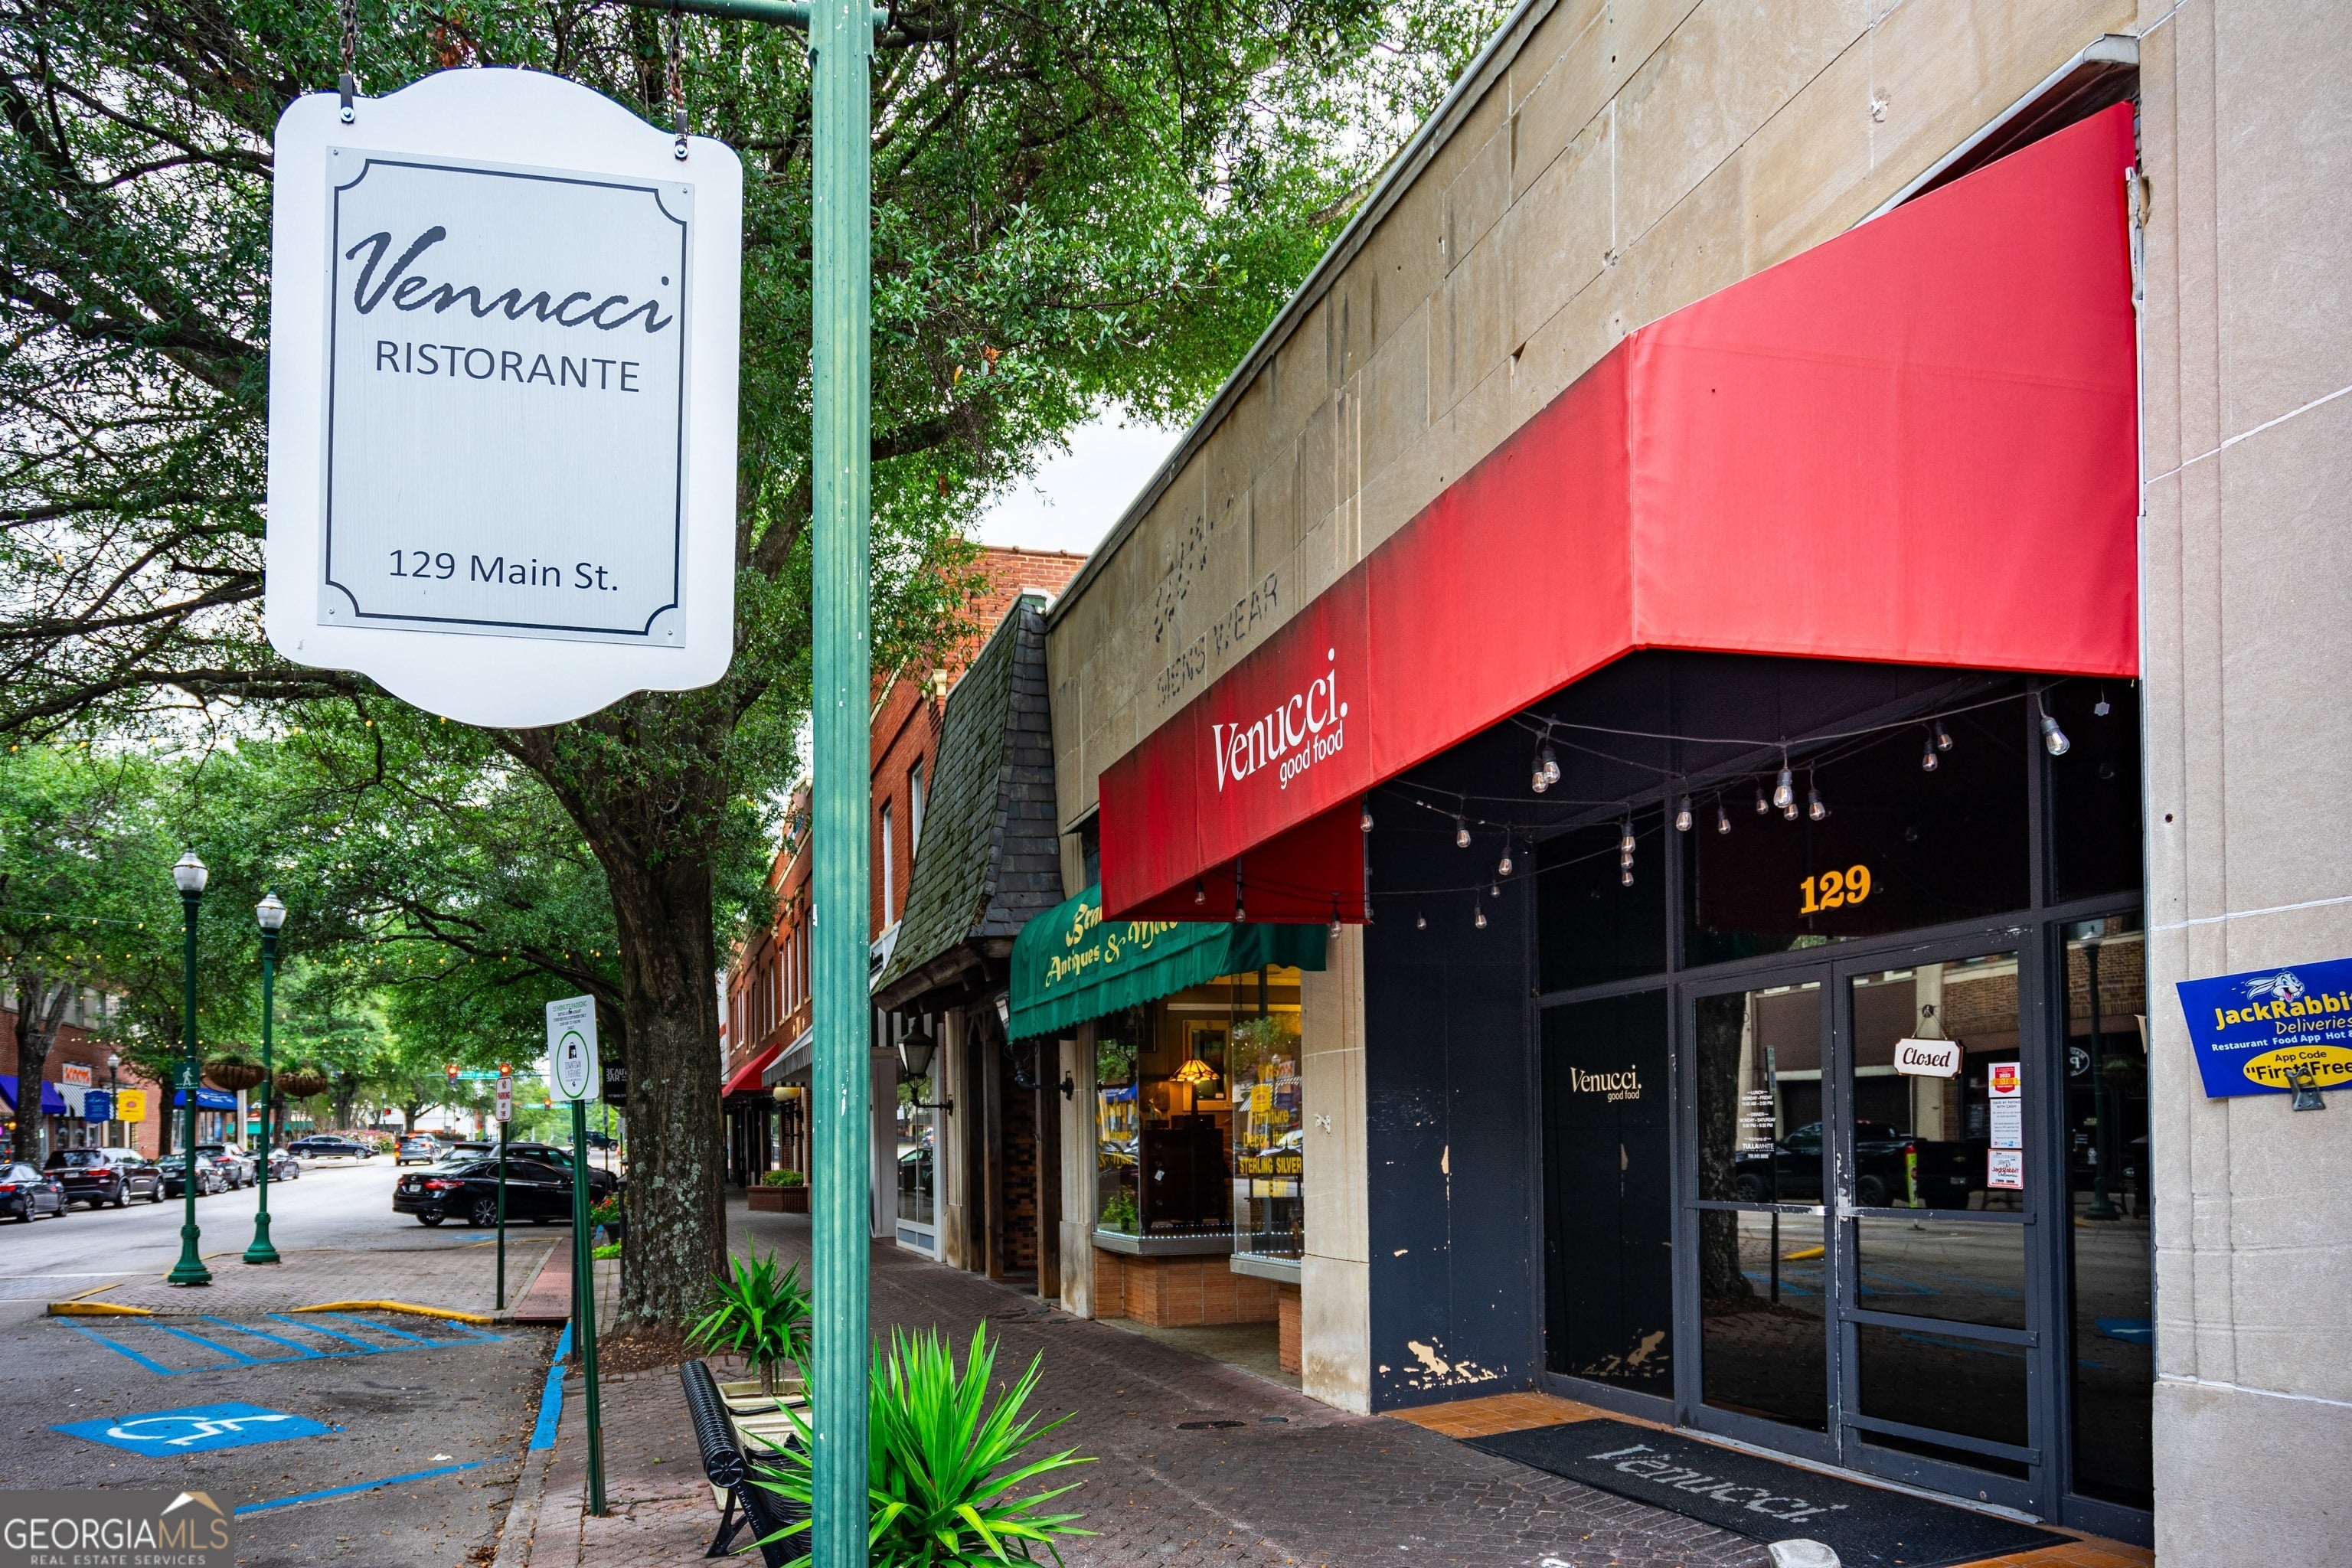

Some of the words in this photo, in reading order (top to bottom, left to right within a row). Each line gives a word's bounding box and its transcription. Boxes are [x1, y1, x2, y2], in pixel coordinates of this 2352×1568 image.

[345, 225, 672, 334] Venucci
[376, 340, 640, 393] RISTORANTE
[388, 550, 456, 580] 129
[470, 554, 562, 588] Main
[574, 562, 619, 592] St.
[1212, 648, 1348, 792] Venucci.
[1279, 740, 1311, 790] good
[1312, 720, 1344, 764] food
[1800, 864, 1871, 914] 129
[1044, 945, 1100, 988] Antiques
[1104, 933, 1126, 964] &
[2214, 991, 2352, 1031] JackRabbi
[2275, 1015, 2352, 1035] Deliveries
[1903, 1047, 1952, 1068] Closed
[2211, 1039, 2269, 1052] Restaurant
[2272, 1036, 2298, 1046] Food
[2300, 1034, 2321, 1044] App
[2325, 1031, 2346, 1040] Hot
[2275, 1054, 2297, 1063] App
[2298, 1050, 2327, 1060] Code
[498, 1091, 511, 1099] PARKING
[1570, 1064, 1642, 1093] Venucci.
[1608, 1090, 1624, 1102] good
[1625, 1089, 1640, 1099] food
[1240, 1157, 1273, 1174] STERLING
[1276, 1157, 1302, 1174] SILVER
[1586, 1444, 1849, 1524] Venucci.
